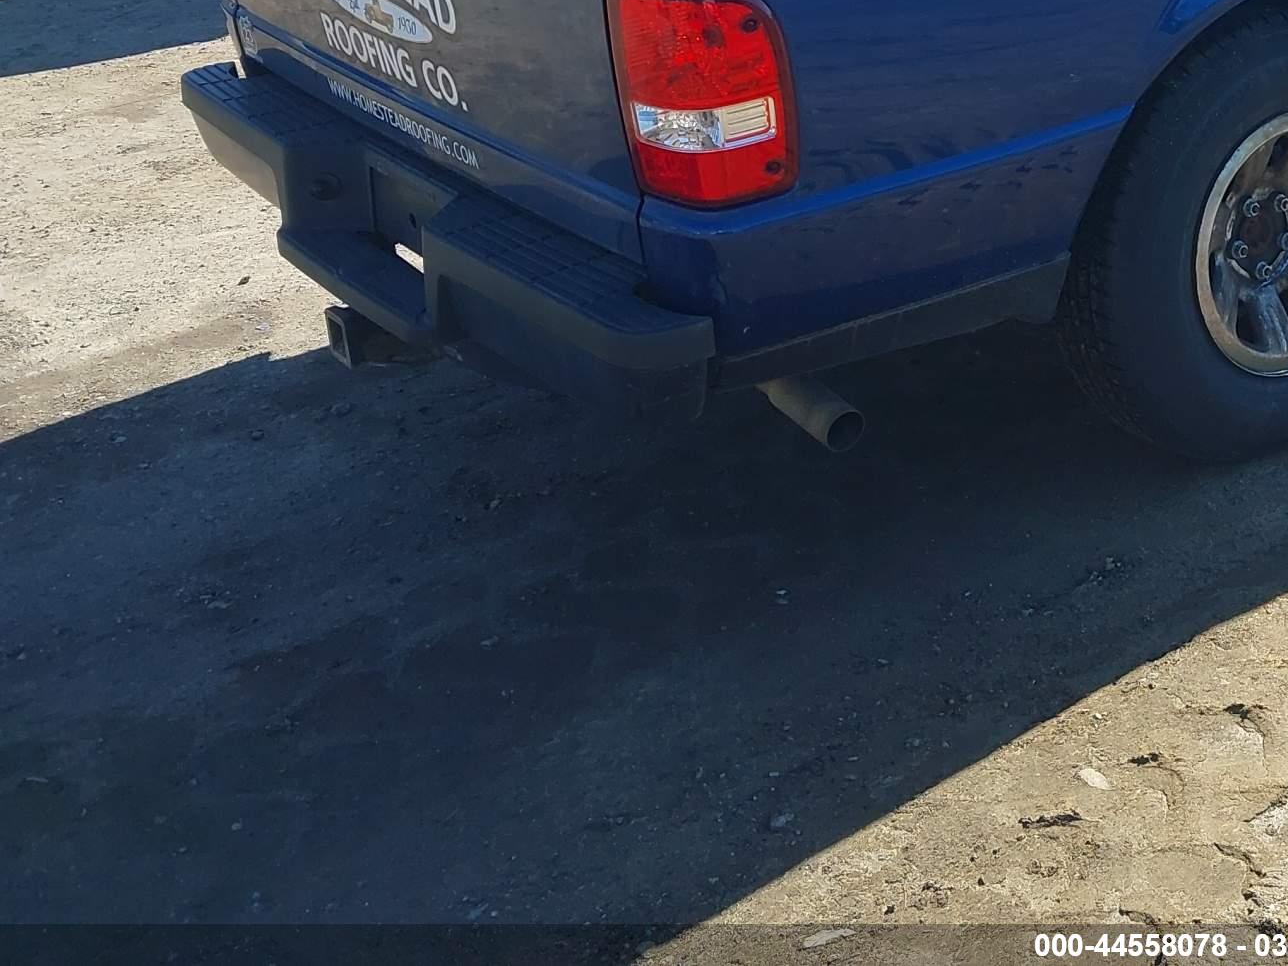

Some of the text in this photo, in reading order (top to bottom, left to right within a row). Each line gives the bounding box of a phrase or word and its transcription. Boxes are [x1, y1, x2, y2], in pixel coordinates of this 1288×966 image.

[320, 12, 418, 89] ROOFING
[422, 58, 470, 112] CO.
[397, 17, 417, 36] 1930
[327, 77, 480, 170] WWW.HOMESTEADROOFING.COM
